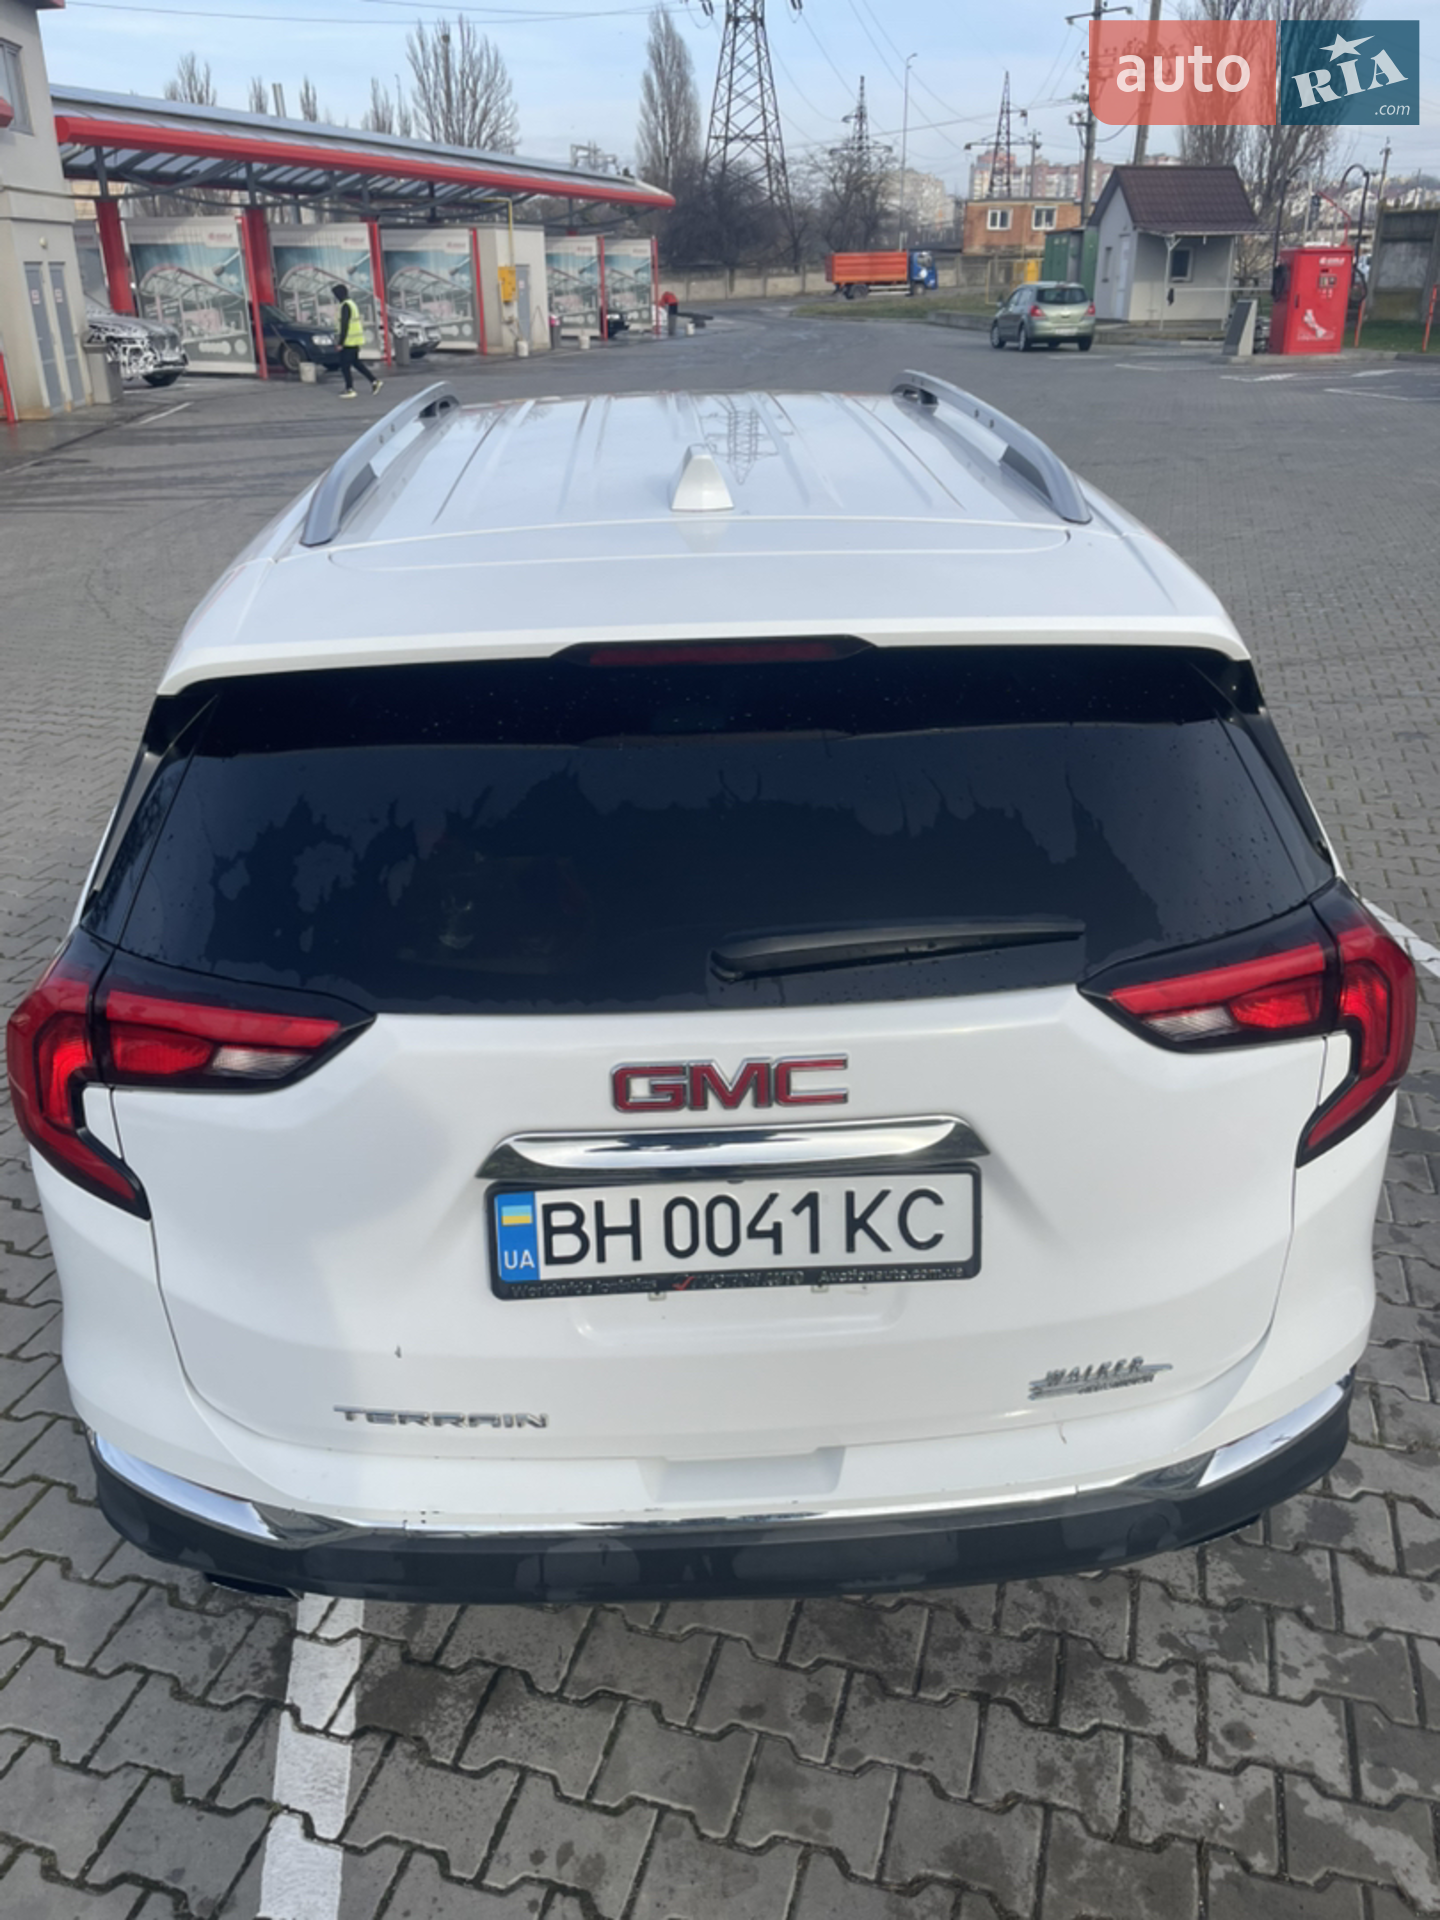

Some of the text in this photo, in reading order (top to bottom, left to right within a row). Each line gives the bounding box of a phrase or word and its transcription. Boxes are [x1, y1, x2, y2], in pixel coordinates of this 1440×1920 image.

[610, 1053, 848, 1113] GMC
[542, 1188, 944, 1266] BH 0041 KC
[504, 1249, 536, 1270] UA
[333, 1404, 549, 1428] TERRAIN
